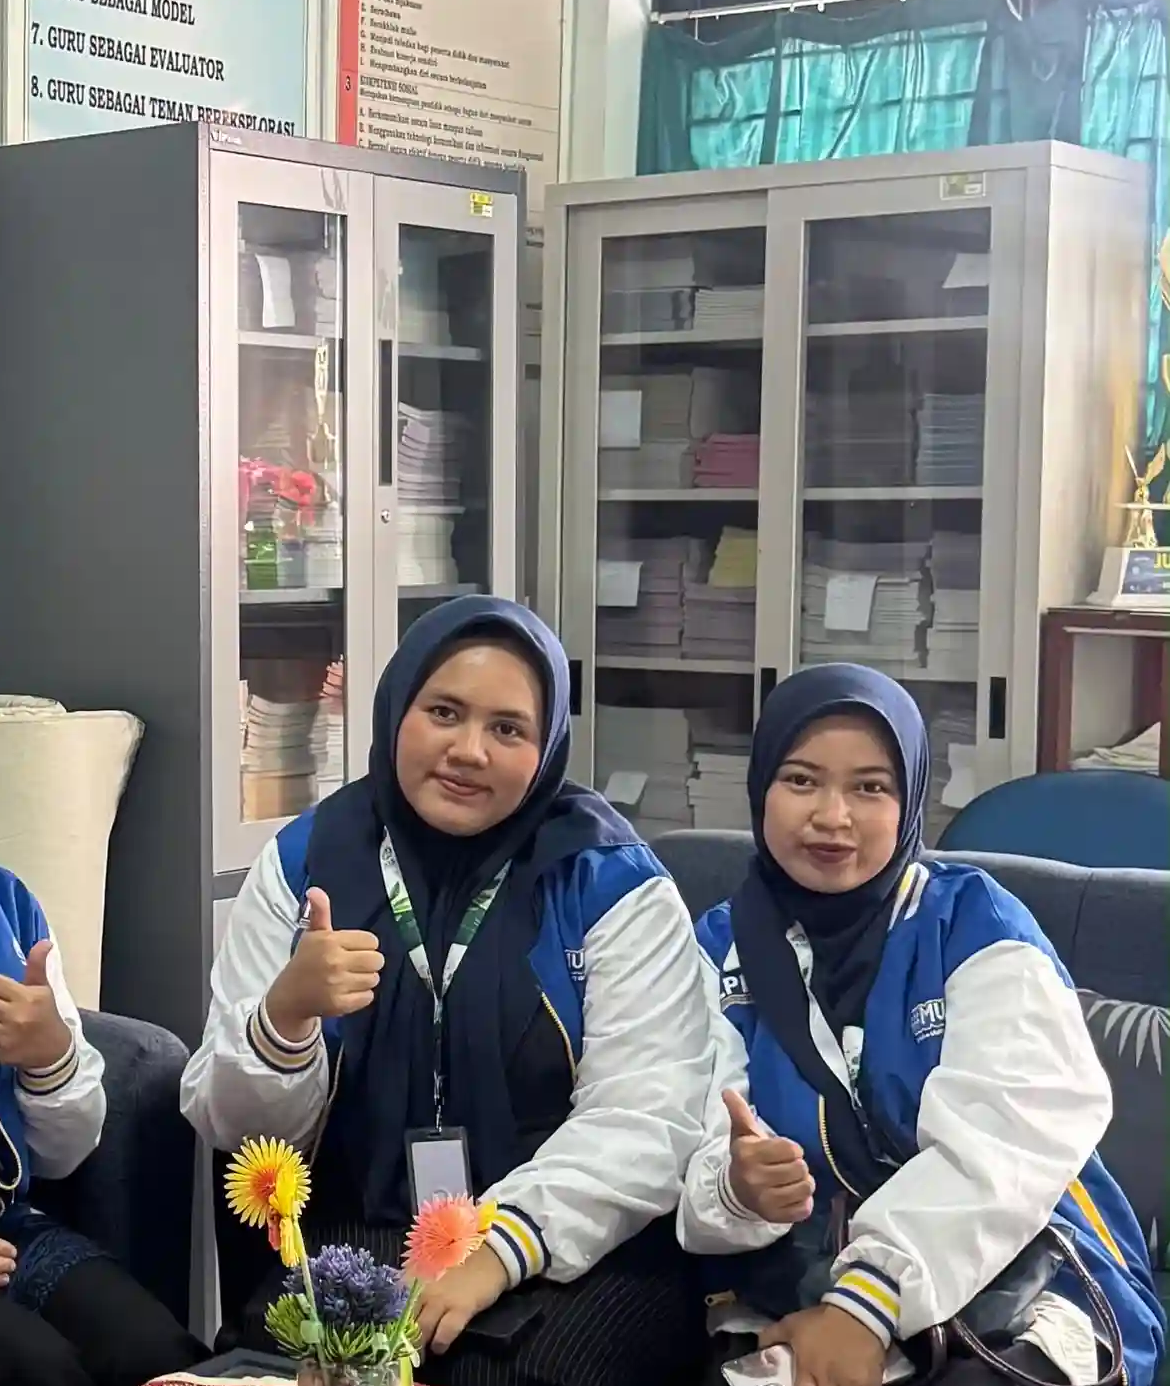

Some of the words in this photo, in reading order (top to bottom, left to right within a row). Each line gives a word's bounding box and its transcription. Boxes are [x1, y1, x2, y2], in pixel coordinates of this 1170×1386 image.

[31, 22, 43, 46] 7.
[48, 26, 85, 54] GURU
[89, 35, 146, 66] SEBAGAI
[150, 46, 224, 82] EVALUATOR
